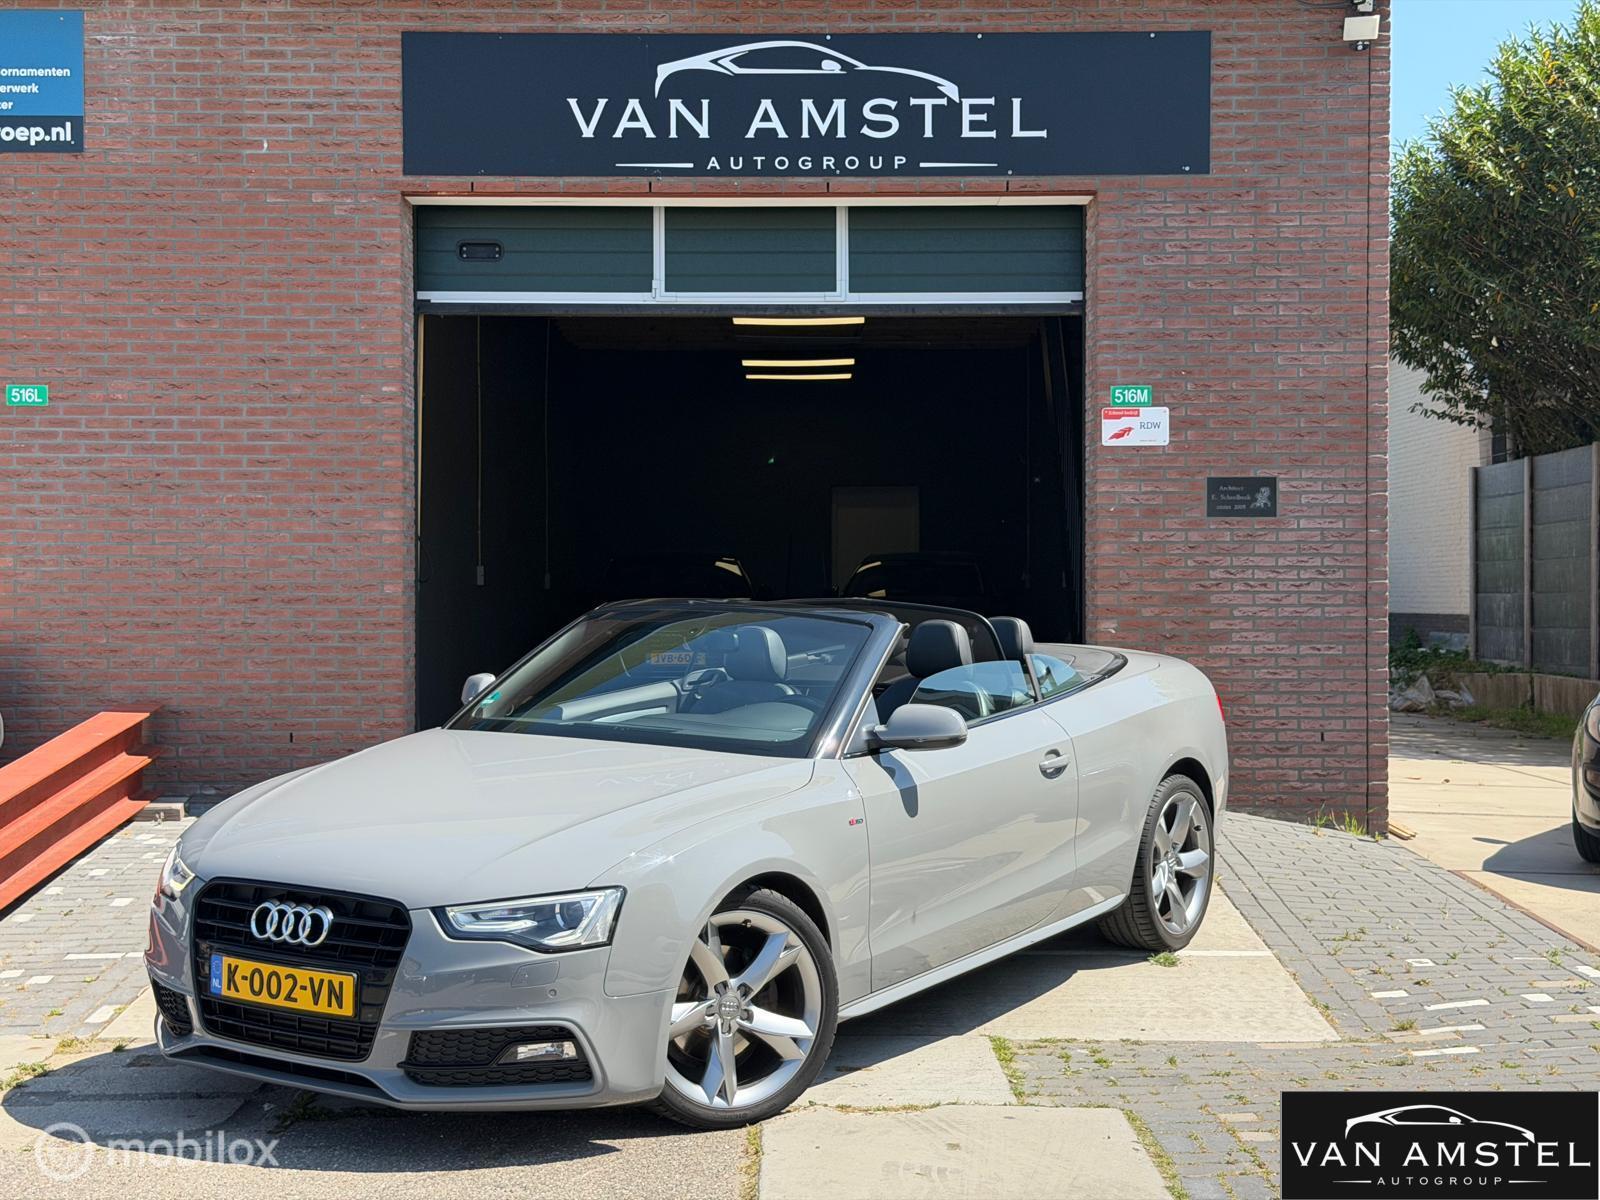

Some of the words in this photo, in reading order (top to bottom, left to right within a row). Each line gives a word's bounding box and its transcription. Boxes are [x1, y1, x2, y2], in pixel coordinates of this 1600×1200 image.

[0, 67, 71, 77] ornamenten
[566, 97, 710, 139] VAN
[744, 97, 1048, 139] AMSTEL
[0, 121, 72, 147] oep.nl
[706, 155, 908, 170] AUTOGROUP
[11, 388, 43, 403] 516L
[1114, 388, 1149, 403] 516M
[1140, 421, 1161, 430] RDW
[212, 978, 222, 988] NL
[226, 963, 344, 1010] K-002-VN
